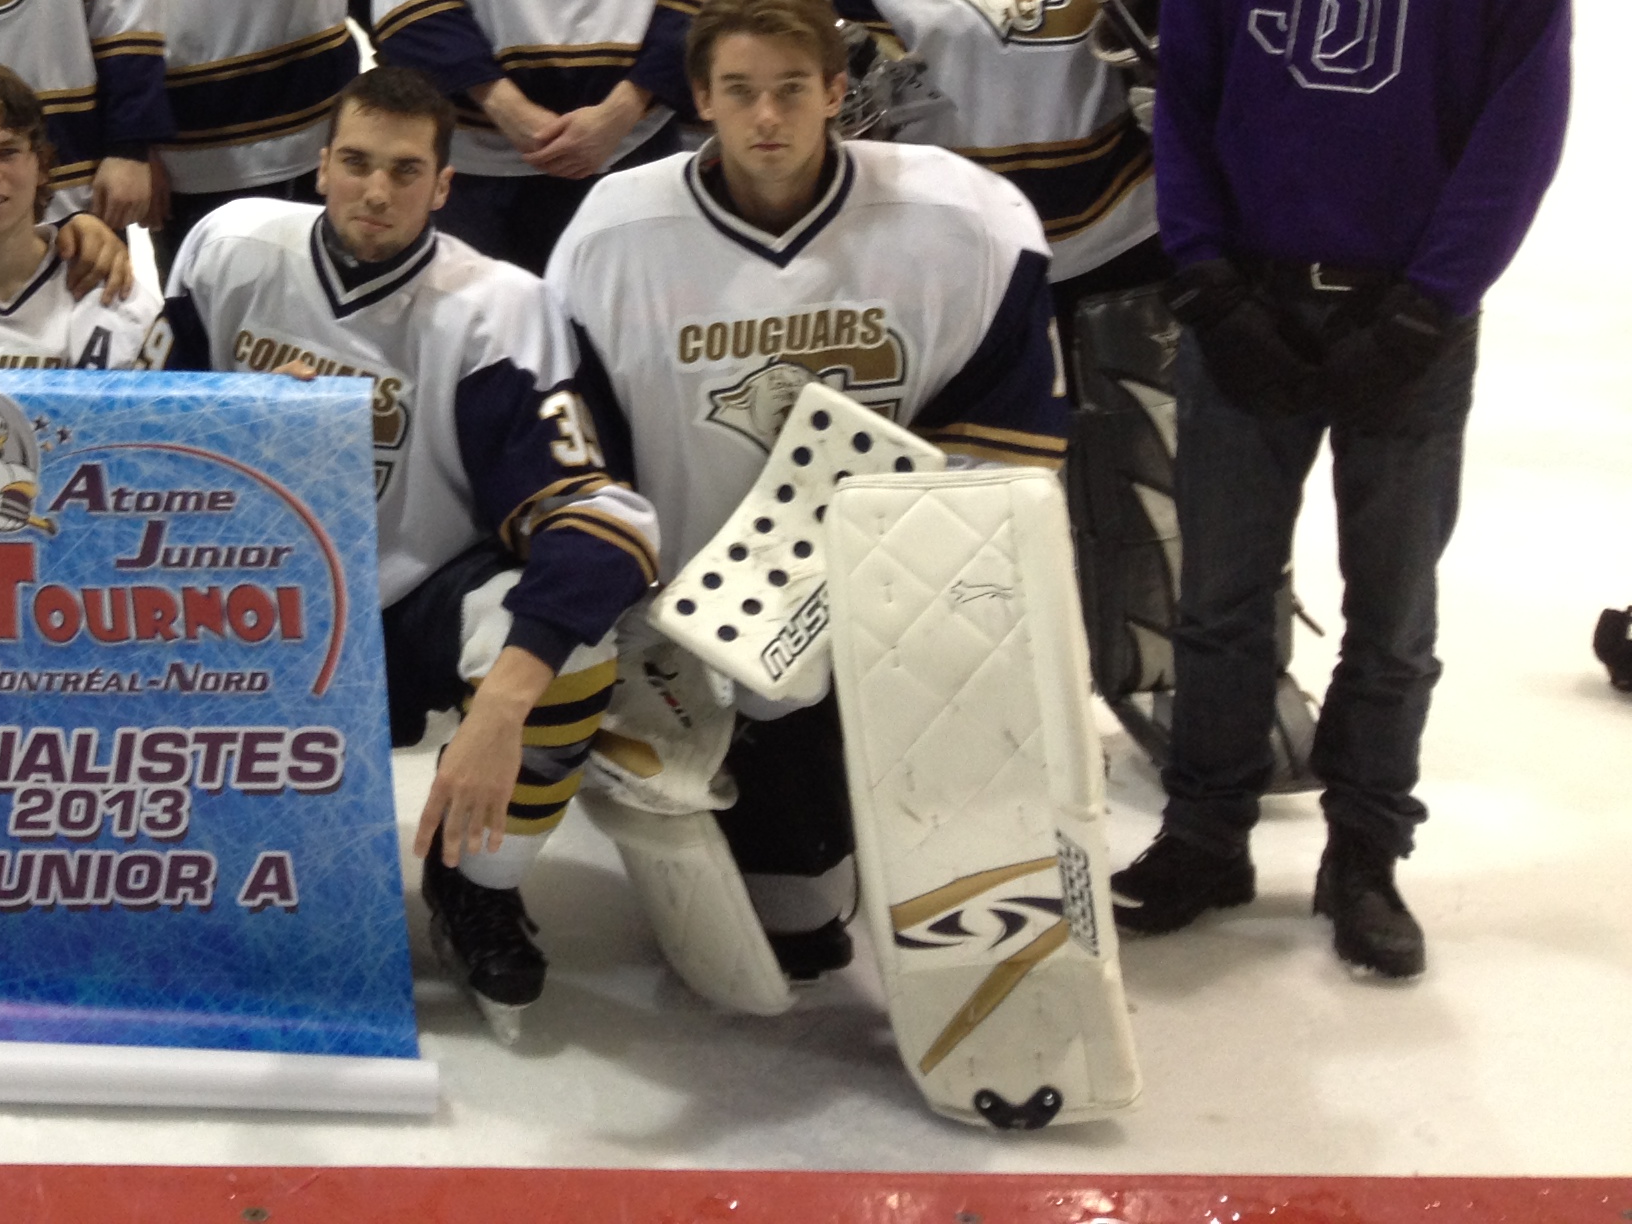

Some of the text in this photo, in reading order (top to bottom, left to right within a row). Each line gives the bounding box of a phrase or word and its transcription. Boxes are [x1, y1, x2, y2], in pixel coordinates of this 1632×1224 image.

[79, 325, 113, 370] A
[677, 308, 885, 364] COUGUARS
[10, 787, 190, 841] 2013
[240, 851, 298, 910] A
